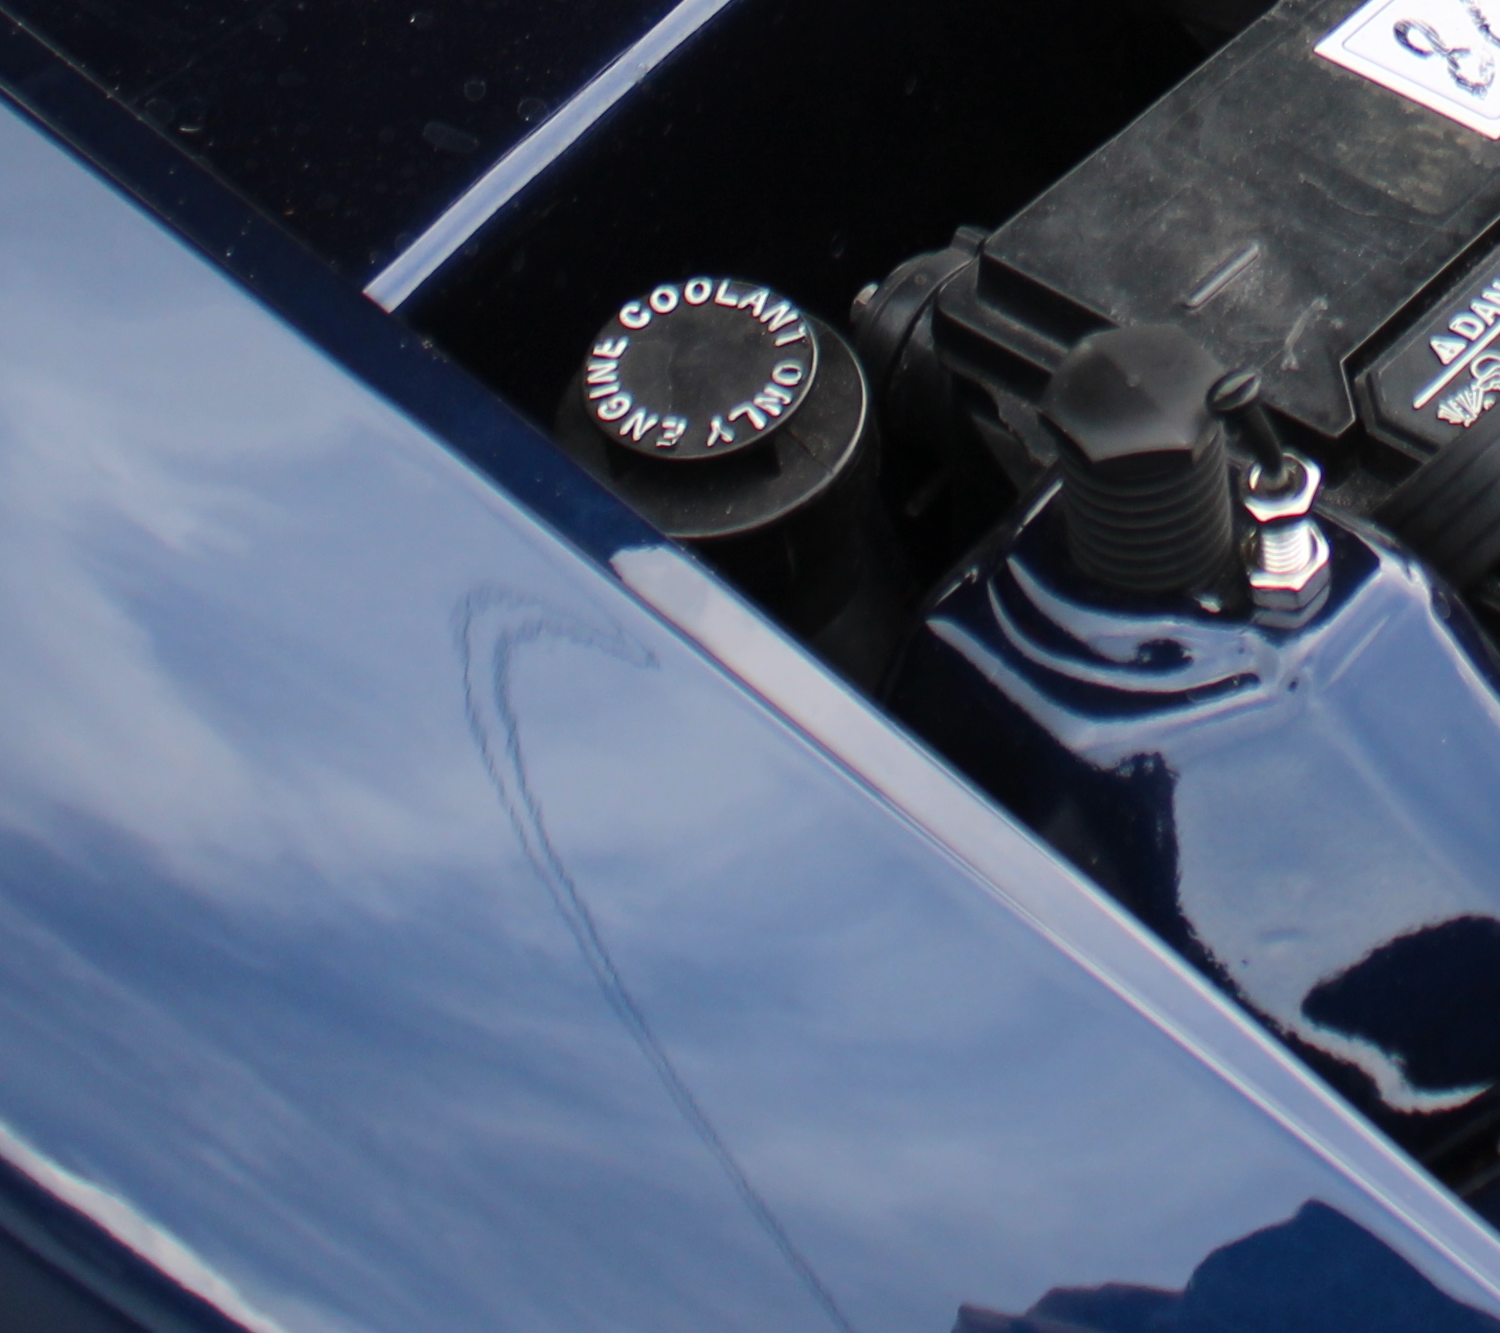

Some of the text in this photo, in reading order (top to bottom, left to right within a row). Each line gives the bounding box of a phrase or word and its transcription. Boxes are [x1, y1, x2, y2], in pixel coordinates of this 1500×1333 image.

[586, 276, 807, 447] ENGINE COOLANT ONLY
